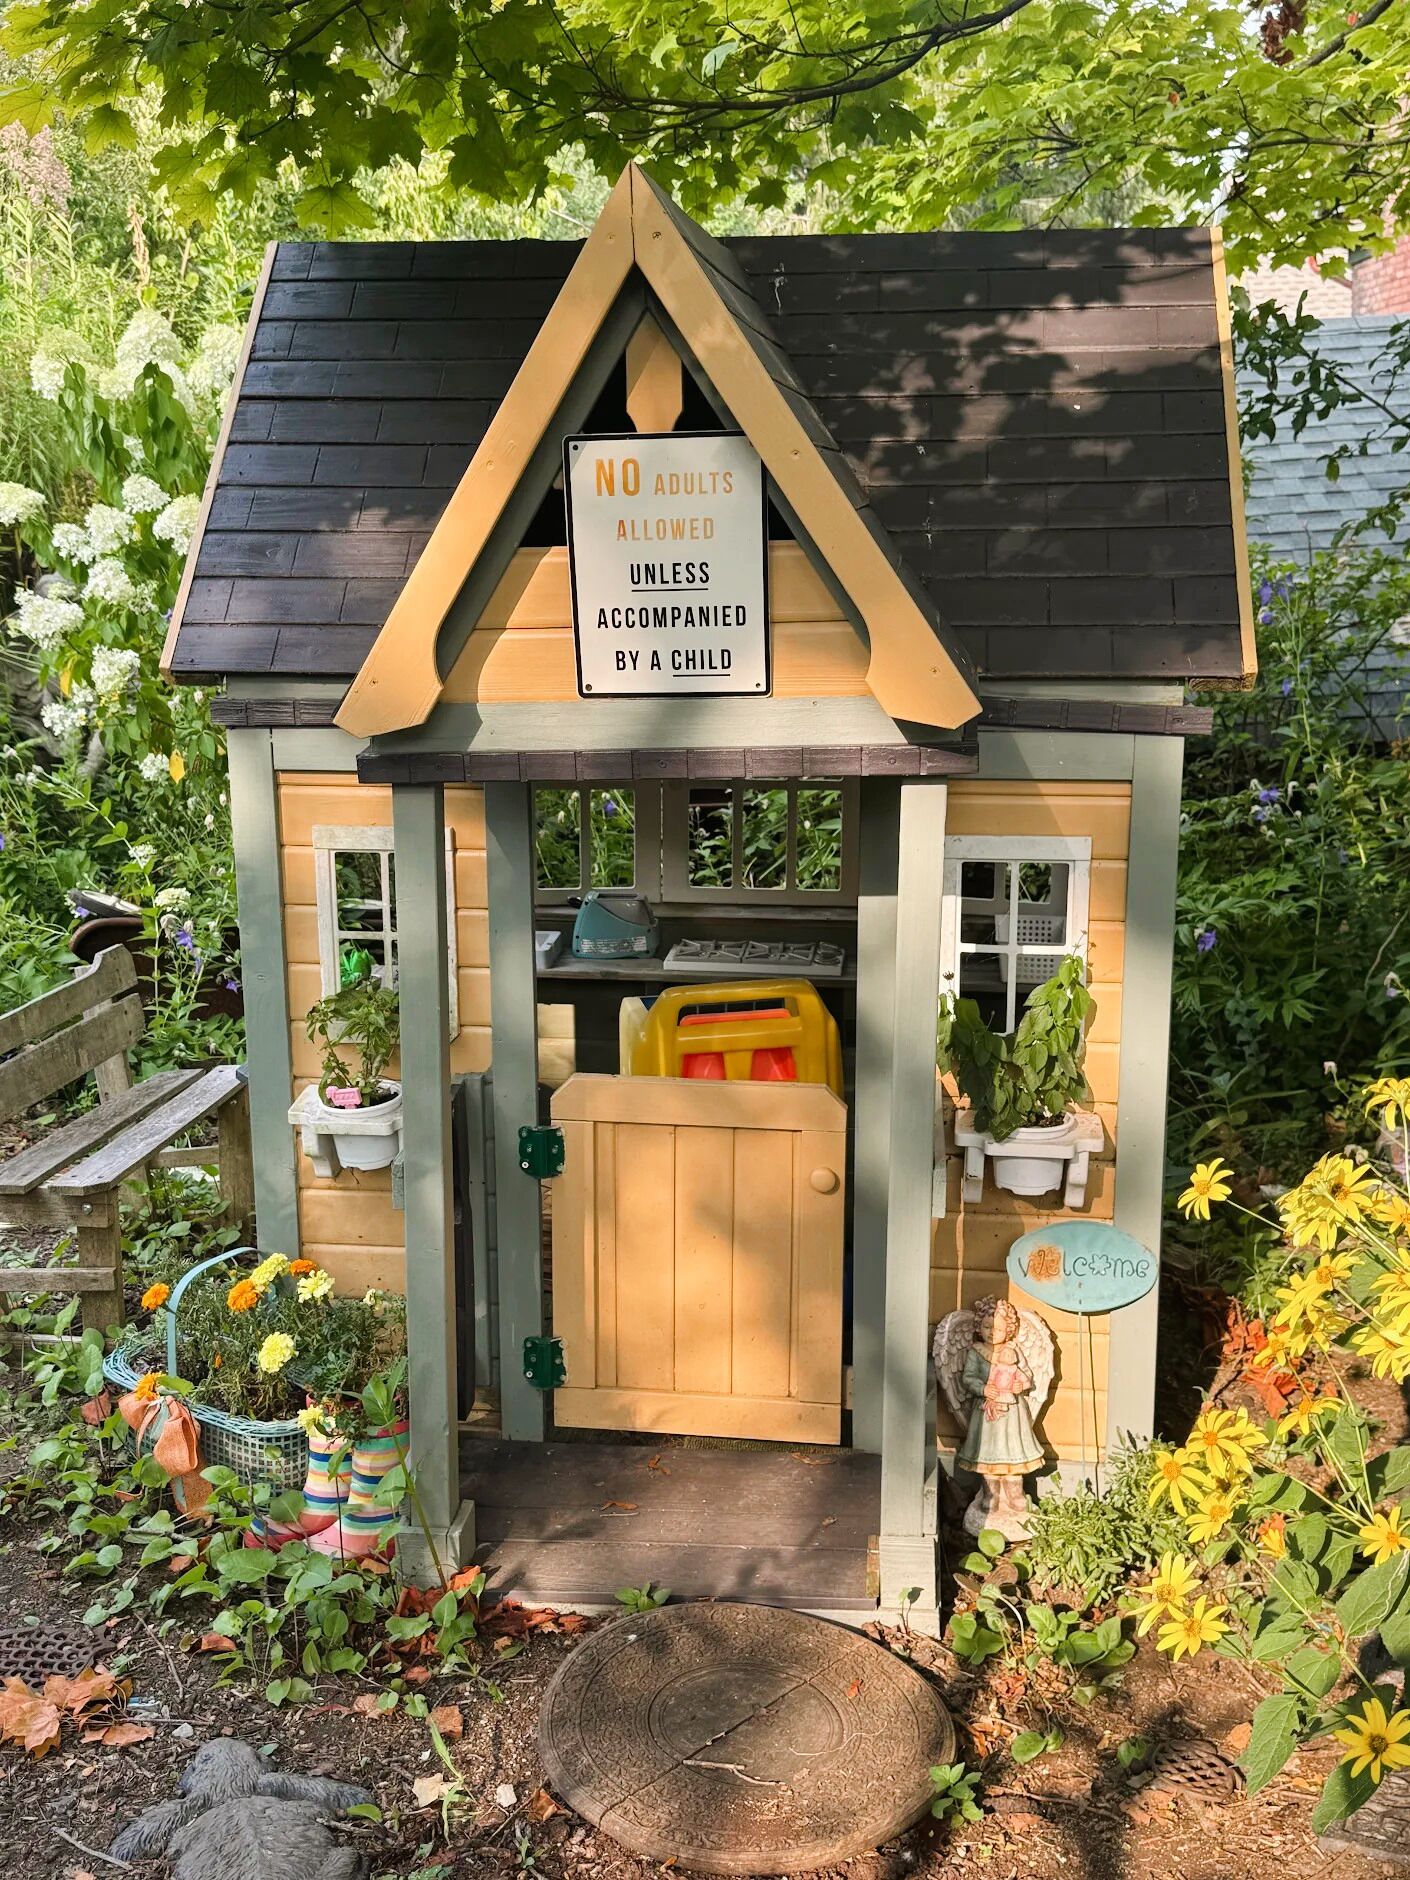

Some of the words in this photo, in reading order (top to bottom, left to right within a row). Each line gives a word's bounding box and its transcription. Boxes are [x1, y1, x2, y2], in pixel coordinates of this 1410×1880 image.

[595, 457, 641, 497] NO
[654, 471, 734, 496] ADULTS
[616, 517, 715, 542] ALLOWED
[630, 561, 710, 585] UNLESS
[597, 605, 747, 629] ACCOMPANIED
[615, 650, 640, 671] BY
[650, 649, 662, 671] A
[671, 648, 732, 671] CHILD
